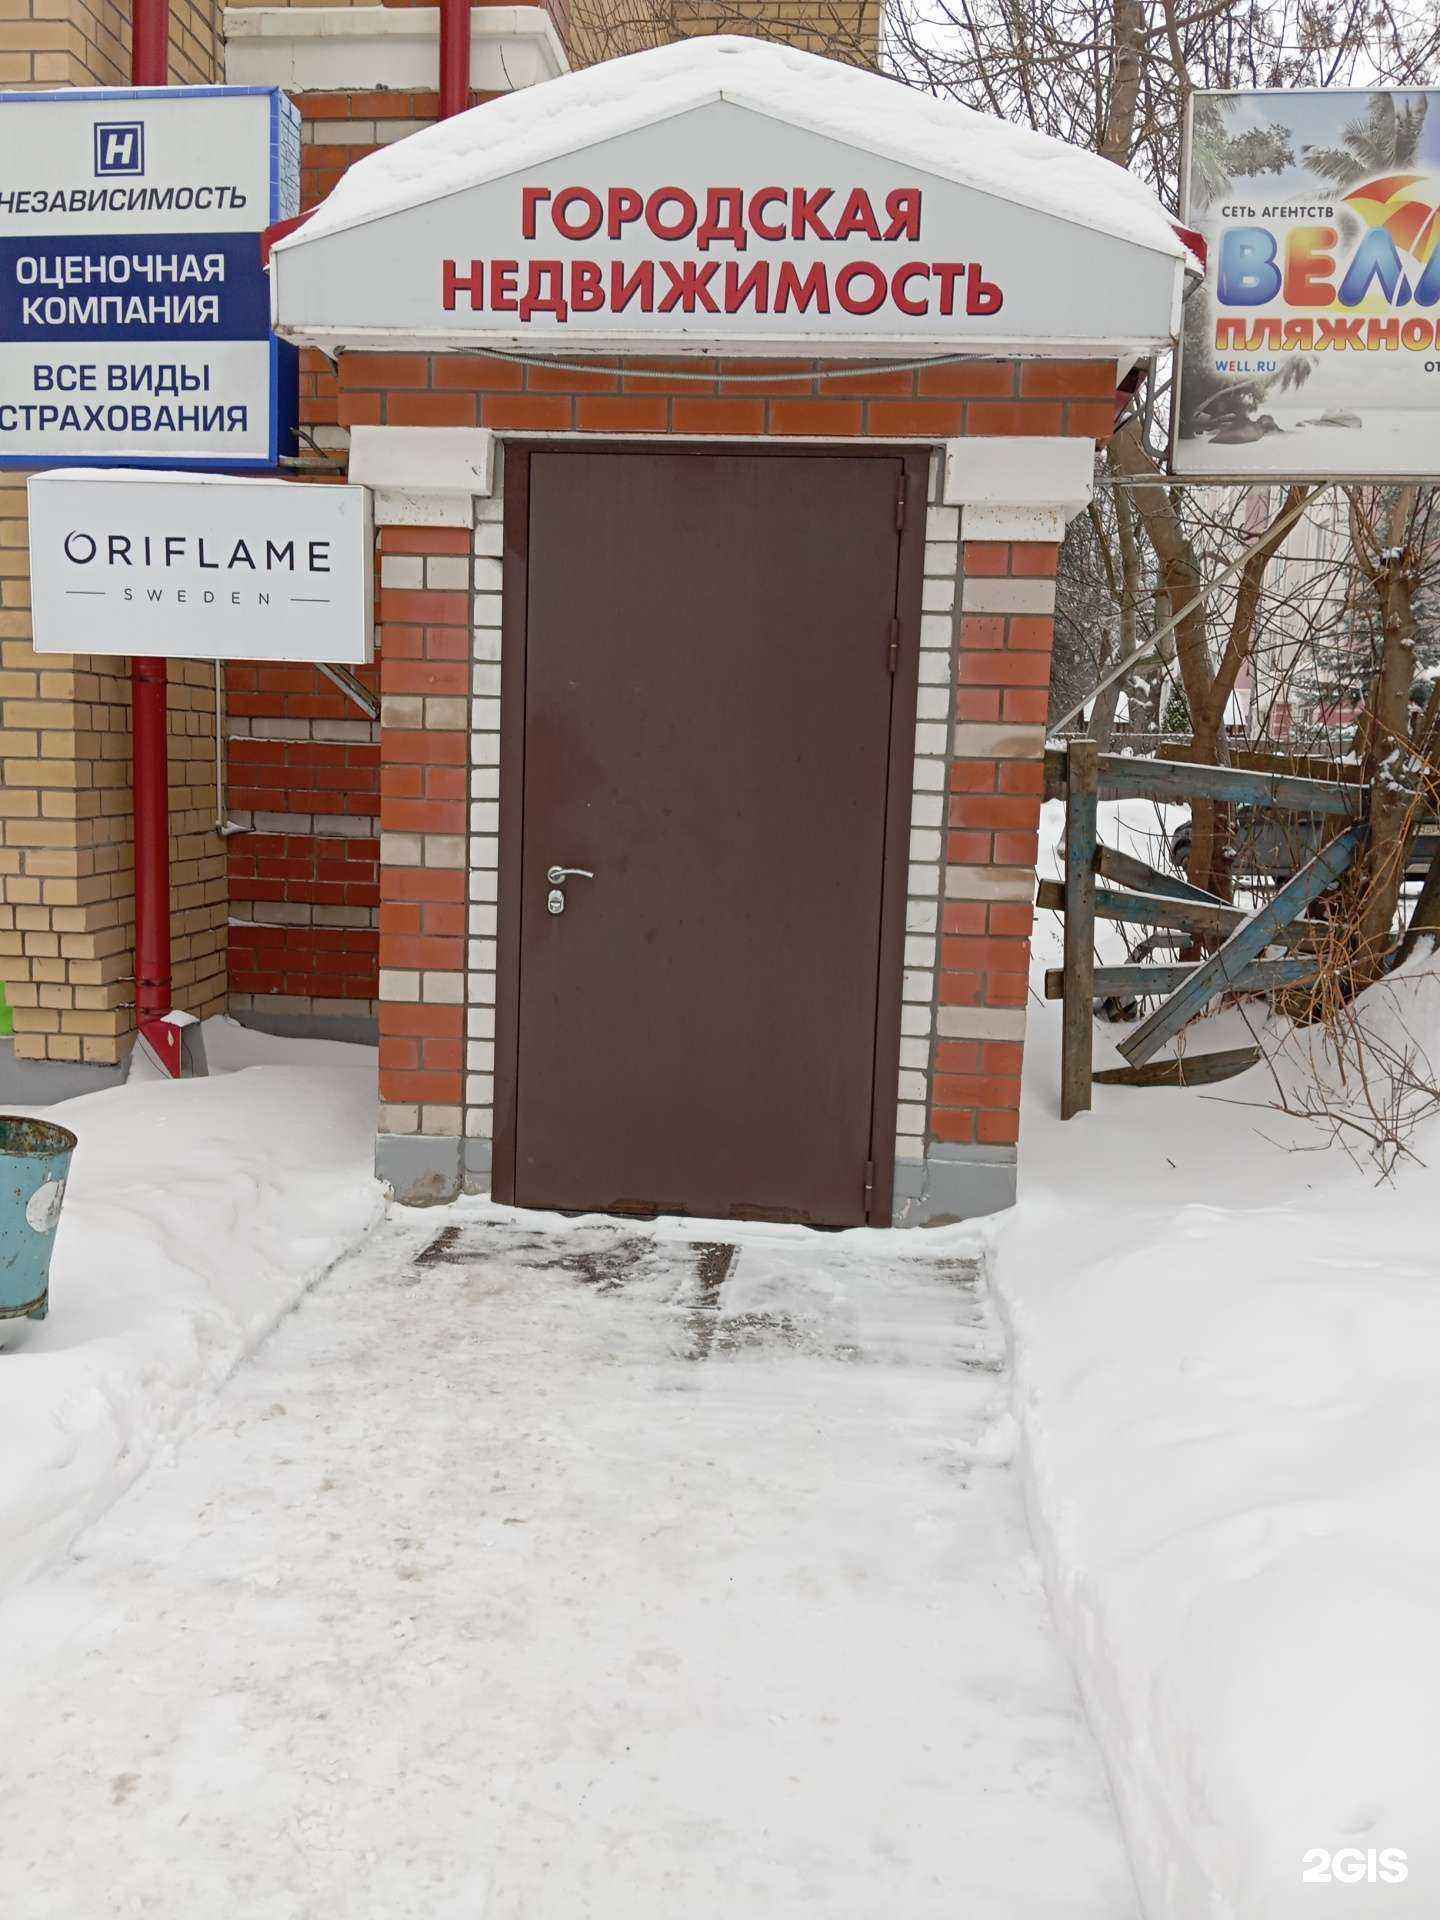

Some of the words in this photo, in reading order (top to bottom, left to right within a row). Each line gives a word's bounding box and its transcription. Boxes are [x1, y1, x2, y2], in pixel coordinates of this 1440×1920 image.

[0, 186, 247, 214] НЕЗАВИСИМОСТЬ
[1222, 206, 1256, 218] СЕТЬ
[1262, 206, 1334, 218] АГЕНТСТВ
[522, 187, 922, 251] ГОРОДСКАЯ
[16, 253, 225, 289] ОЦЕНОЧНАЯ
[442, 259, 1004, 323] НЕДВИЖИМОСТЬ
[22, 295, 220, 325] КОМПАНИЯ
[1215, 317, 1440, 351] ПЛЯЖНО
[33, 364, 97, 391] ВСЕ
[107, 364, 210, 397] ВИДЫ
[1215, 360, 1277, 372] WELL.RU
[0, 405, 248, 432] СТРАХОВАНИЯ
[64, 530, 331, 572] ORIFLAME
[124, 588, 270, 605] SWEDEN
